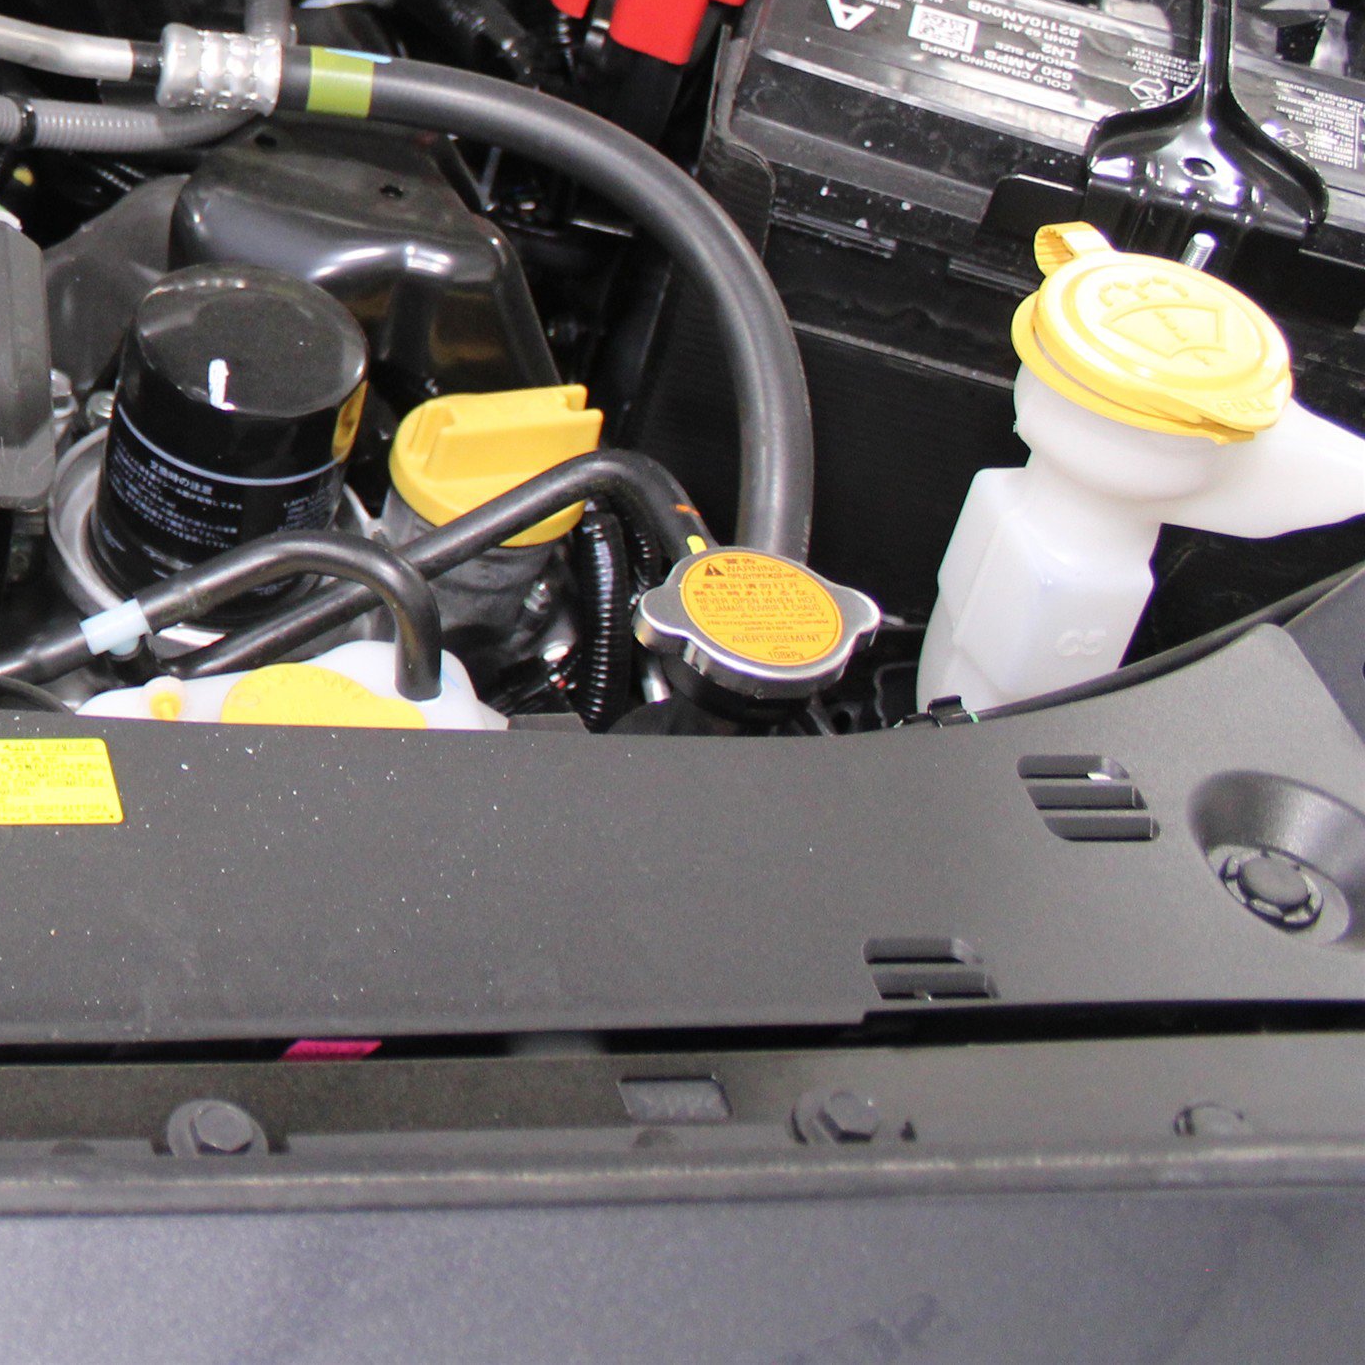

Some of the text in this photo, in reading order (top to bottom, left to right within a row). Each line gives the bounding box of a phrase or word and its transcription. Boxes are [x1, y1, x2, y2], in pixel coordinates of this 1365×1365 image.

[1002, 21, 1022, 32] AH
[994, 41, 1024, 55] SIZE
[1041, 43, 1077, 60] LN2
[919, 42, 1071, 91] COLD CRANKING AMPS
[984, 50, 1073, 82] 620 AMPS
